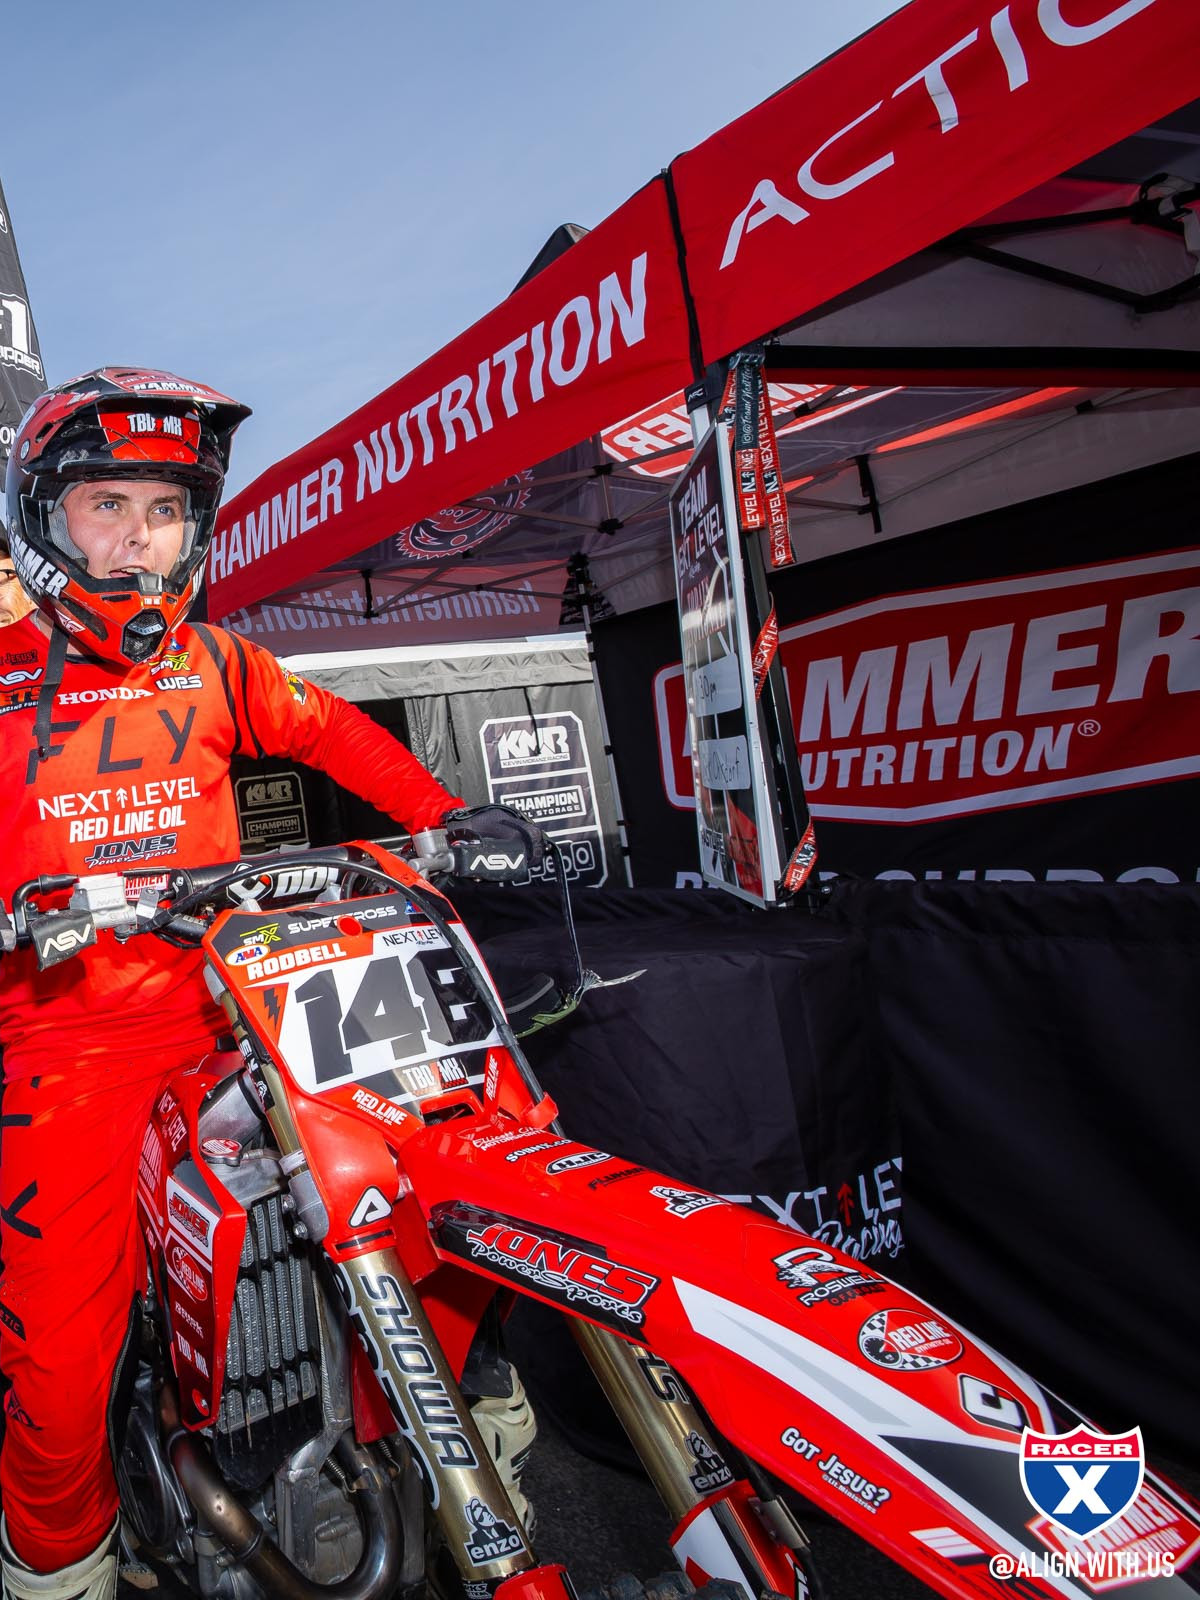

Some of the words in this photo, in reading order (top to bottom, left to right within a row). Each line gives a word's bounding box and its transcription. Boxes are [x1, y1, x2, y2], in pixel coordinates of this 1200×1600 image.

[210, 458, 344, 585] HAMMER
[353, 252, 648, 503] NUTRITION
[800, 586, 1200, 743] MMER
[57, 686, 155, 705] HONDA
[155, 675, 204, 692] WPS
[25, 705, 198, 785] FLY
[38, 789, 112, 820] NEXT
[132, 776, 201, 807] LEVEL
[69, 816, 109, 843] RED
[113, 810, 155, 836] LINE
[158, 805, 187, 829] OIL
[249, 818, 298, 833] CHAMPION
[84, 833, 178, 862] JONES
[469, 853, 525, 872] ASV
[42, 924, 92, 959] ASV
[240, 923, 283, 945] SMX
[383, 931, 417, 947] NEXT
[235, 946, 264, 964] AMA
[247, 943, 348, 981] RODBELL
[436, 1057, 465, 1081] MX
[352, 1089, 379, 1111] RED
[376, 1102, 408, 1126] LINE
[466, 1223, 661, 1307] JONES
[799, 1272, 890, 1308] ROSWELL
[888, 1324, 925, 1351] RED
[915, 1319, 952, 1342] LINE
[360, 1271, 480, 1471] SHOWA
[780, 1426, 821, 1460] GOT
[817, 1453, 891, 1507] JESUS?
[470, 1534, 520, 1560] enzo
